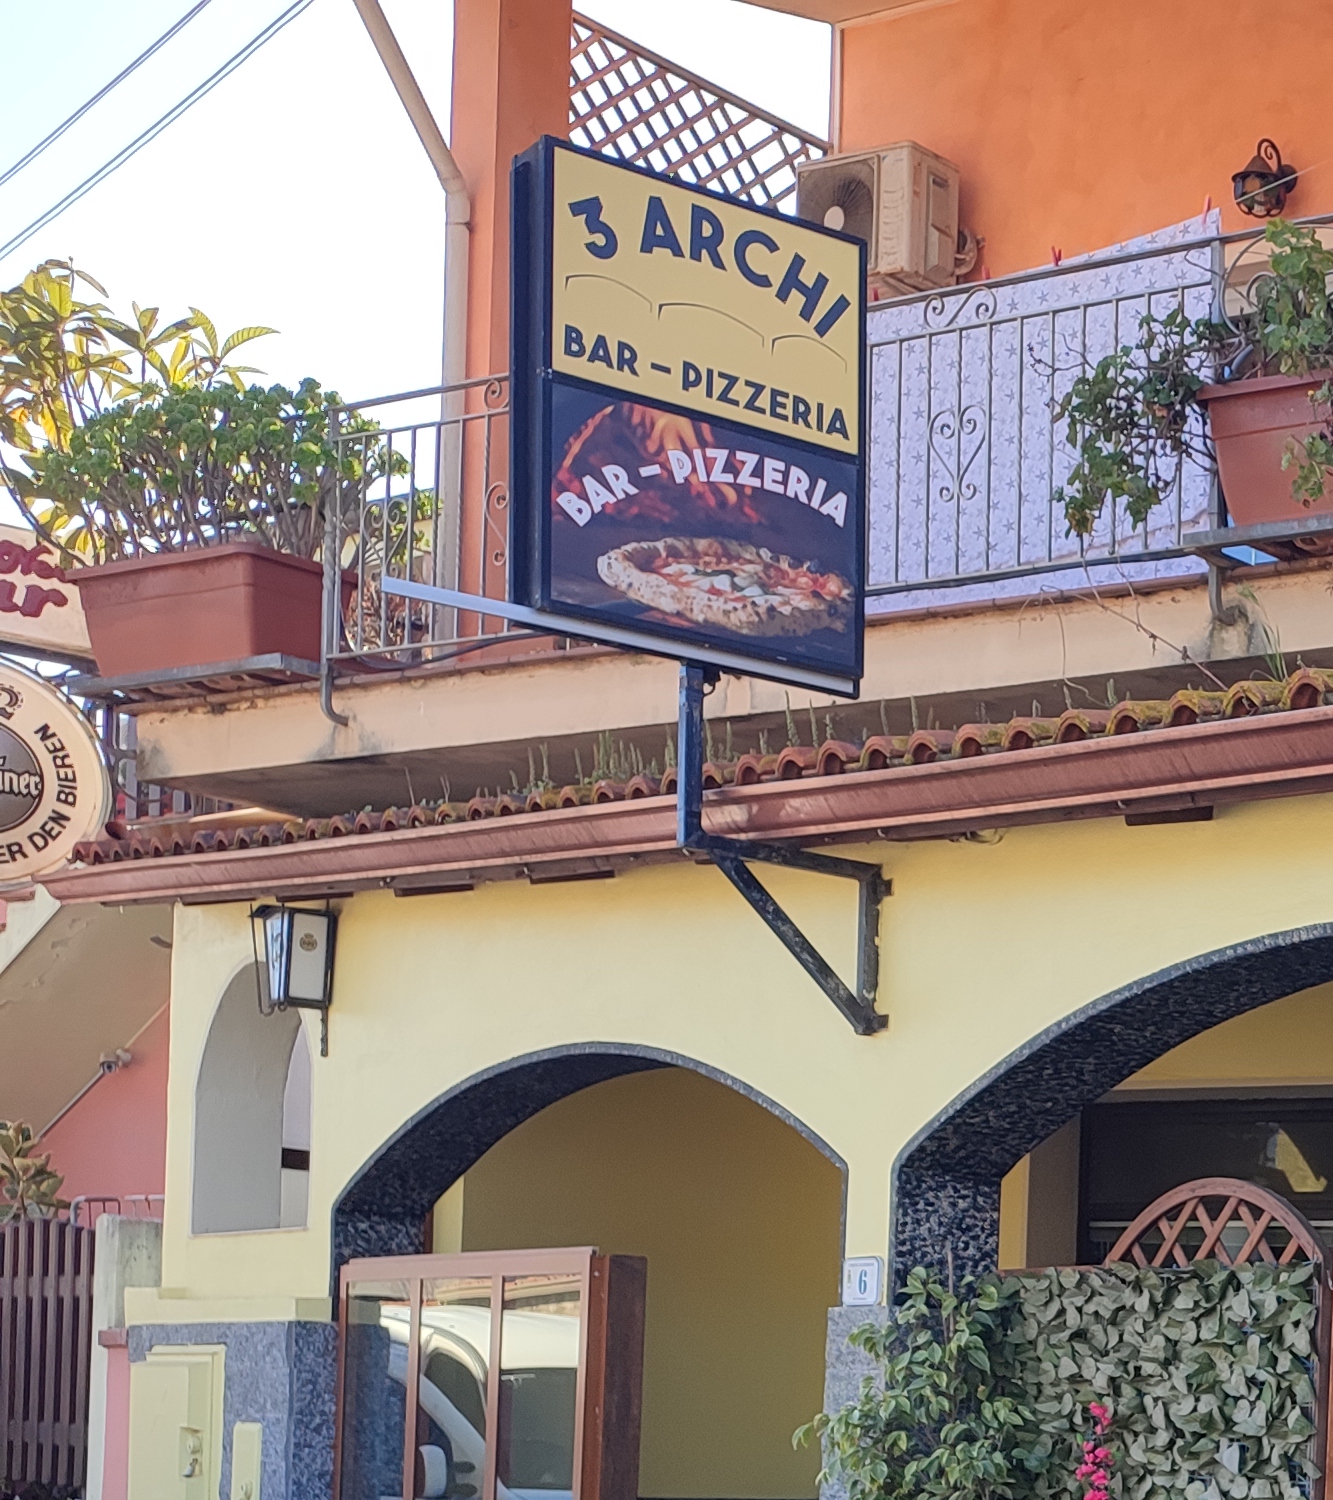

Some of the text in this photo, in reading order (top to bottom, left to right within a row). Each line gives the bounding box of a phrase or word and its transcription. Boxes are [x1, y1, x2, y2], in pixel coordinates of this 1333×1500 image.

[568, 195, 851, 338] 3 ARCHI
[564, 324, 640, 377] BAR
[682, 360, 850, 440] PIZZERIA
[556, 464, 640, 528] BAR
[667, 447, 849, 529] PIZZERIA
[34, 723, 77, 807] BIEREN
[27, 809, 71, 852] DEN
[858, 1269, 867, 1295] 6
